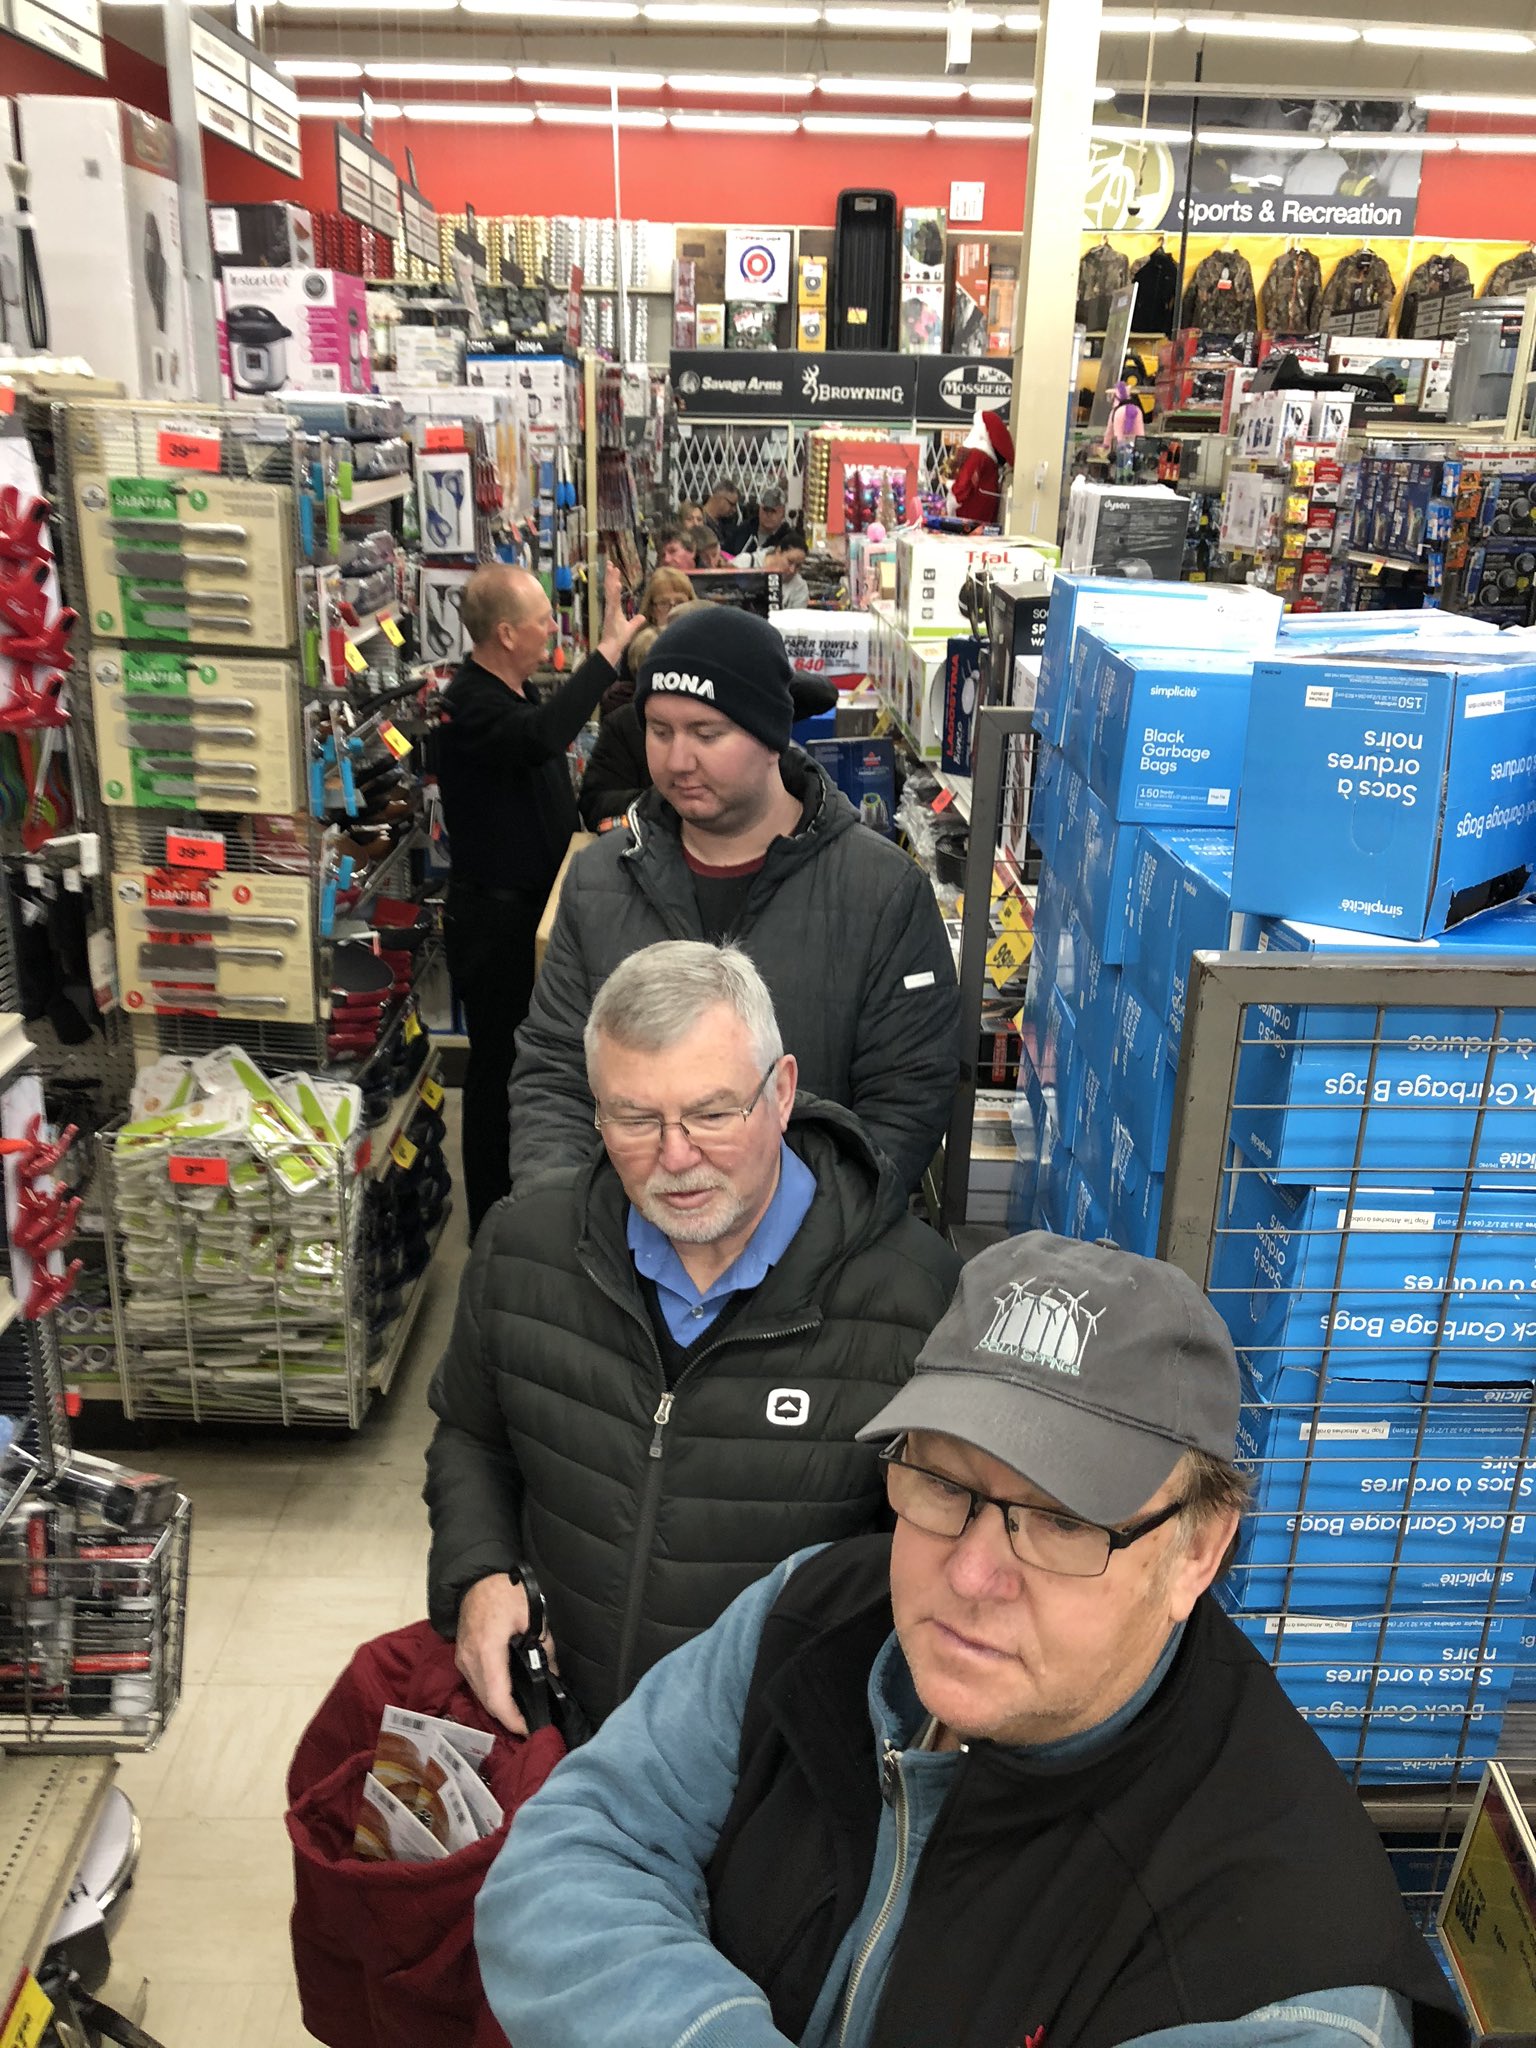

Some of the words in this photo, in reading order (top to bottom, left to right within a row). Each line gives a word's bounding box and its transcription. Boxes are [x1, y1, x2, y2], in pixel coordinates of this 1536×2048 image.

[1178, 198, 1252, 226] Sports
[1259, 201, 1275, 222] &
[1282, 200, 1402, 226] Recreation
[701, 375, 746, 393] Savage
[748, 375, 783, 391] Arms
[819, 382, 904, 403] BROWNING
[943, 380, 1012, 396] MOSSBERG
[1104, 499, 1130, 511] dyson
[966, 551, 1012, 565] T-fal
[785, 639, 815, 650] PAPER
[819, 640, 858, 650] TOWELS
[794, 657, 825, 671] 640
[651, 671, 715, 701] RONA
[1150, 685, 1198, 699] simplicité
[1398, 696, 1423, 709] 150
[1143, 728, 1185, 744] Black
[1363, 730, 1424, 753] noirs
[1142, 743, 1210, 762] Garbage
[1139, 756, 1177, 775] Bags
[1327, 752, 1421, 777] ordures
[1490, 757, 1526, 783] ordures
[1139, 787, 1159, 799] 150
[1337, 779, 1353, 799] à
[1360, 780, 1418, 805] Sacs
[1456, 812, 1484, 839] Bags
[1485, 805, 1525, 828] Garbage
[150, 888, 207, 903] SABATIER
[1341, 898, 1403, 918] simplicité
[1407, 1033, 1510, 1060] ordures
[1324, 1072, 1391, 1103] Bags
[1397, 1074, 1518, 1105] Garbage
[1269, 1214, 1291, 1246] noirs
[1259, 1254, 1283, 1290] Sacs
[1404, 1274, 1503, 1299] ordures
[1506, 1278, 1525, 1300] à
[1320, 1310, 1385, 1339] Bags
[1389, 1313, 1506, 1342] Garbage
[1360, 1477, 1451, 1497] ordures
[1457, 1477, 1472, 1496] à
[1477, 1476, 1533, 1497] Sacs
[1286, 1514, 1345, 1536] Bags
[1349, 1513, 1457, 1536] Garbage
[1463, 1515, 1526, 1536] Back
[1442, 1646, 1497, 1661] noirs
[1326, 1668, 1414, 1687] ordures
[1418, 1668, 1434, 1686] à
[1439, 1667, 1493, 1687] Sacs
[1314, 1700, 1418, 1723] Garbage
[1423, 1703, 1485, 1723] Back
